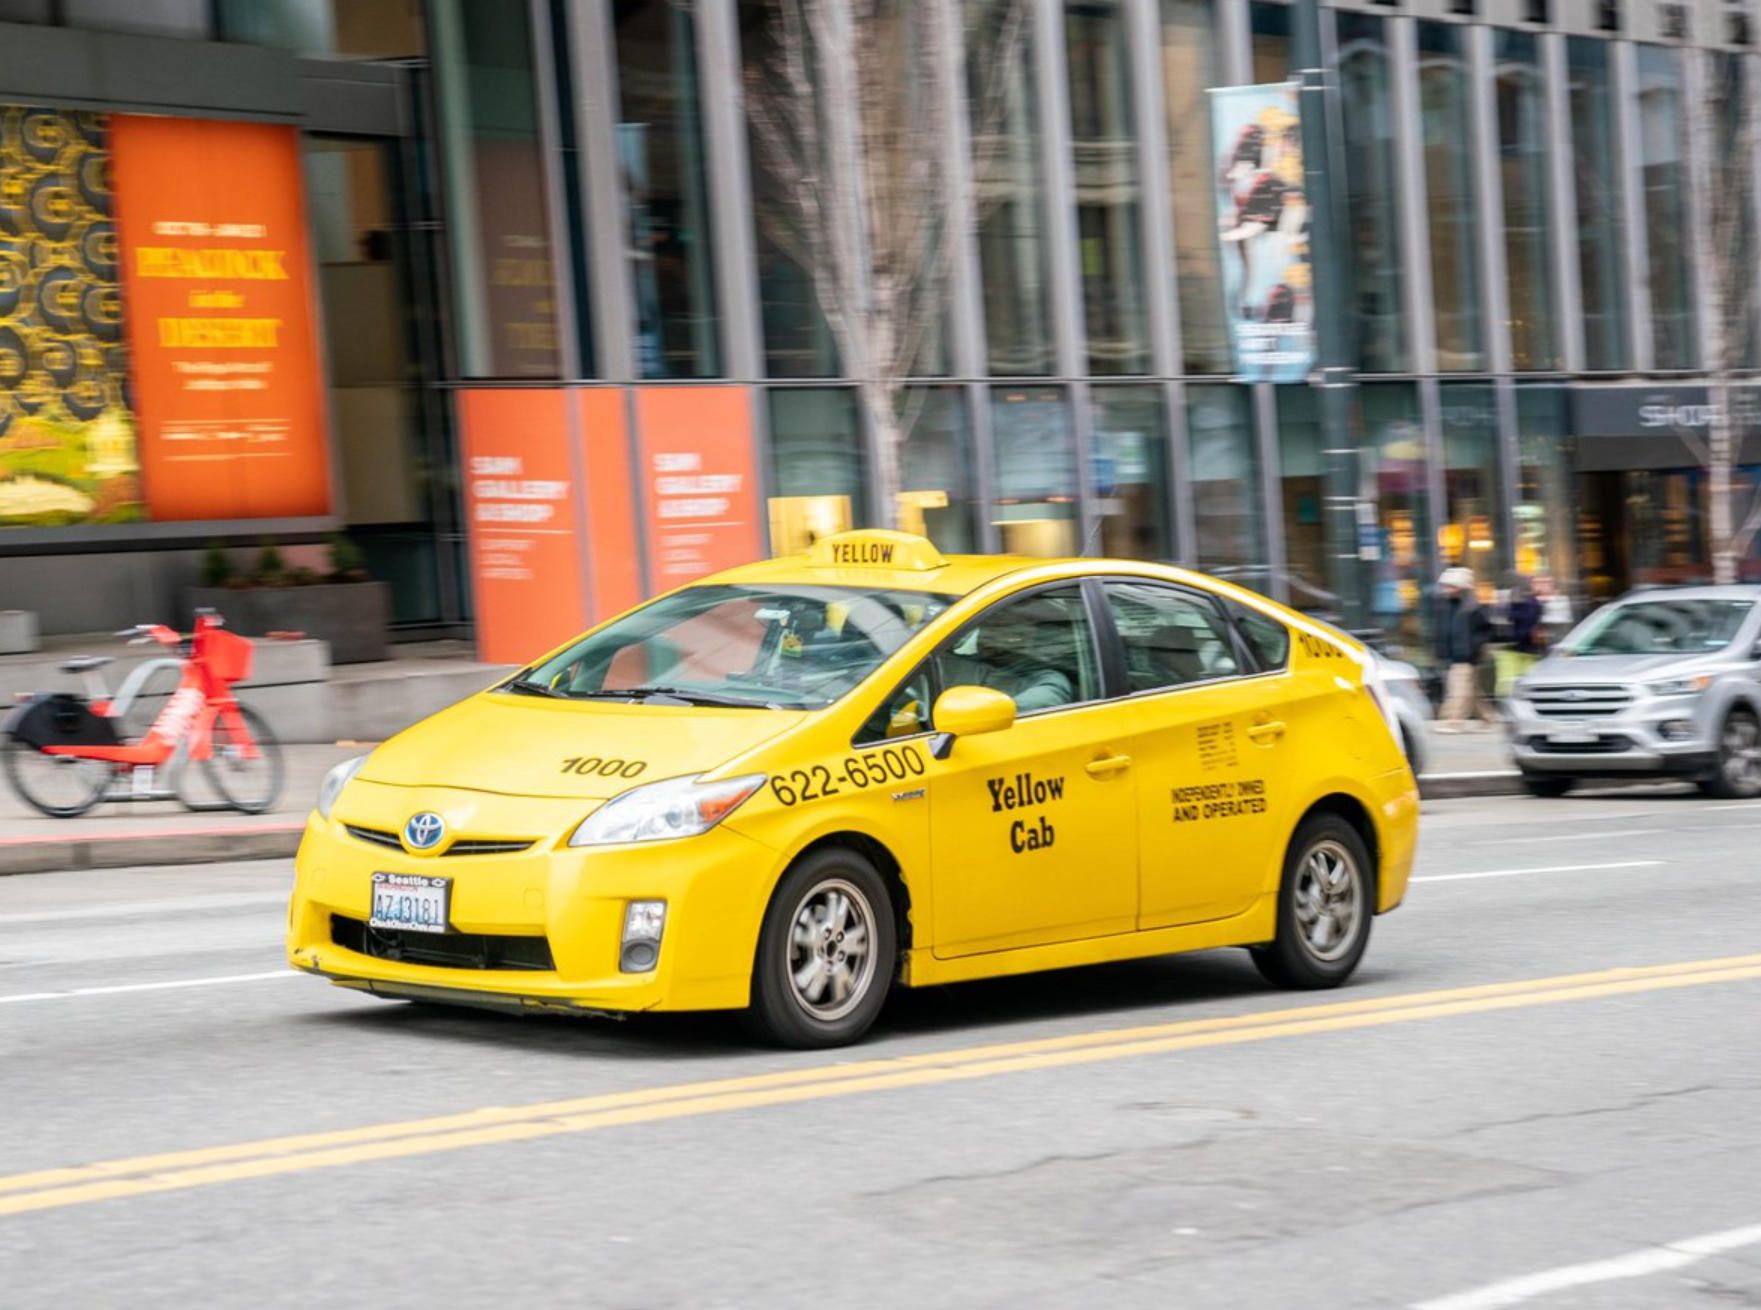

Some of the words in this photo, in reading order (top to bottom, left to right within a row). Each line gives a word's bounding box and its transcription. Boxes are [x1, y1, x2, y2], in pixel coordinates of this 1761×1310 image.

[832, 543, 894, 563] YELLOW
[560, 757, 648, 779] 1000
[770, 745, 925, 807] 622-6500
[987, 772, 1064, 812] Yellow
[1173, 804, 1199, 822] AND
[1203, 797, 1267, 819] OPERATED
[1010, 816, 1055, 854] Cab
[388, 874, 429, 888] Seattle
